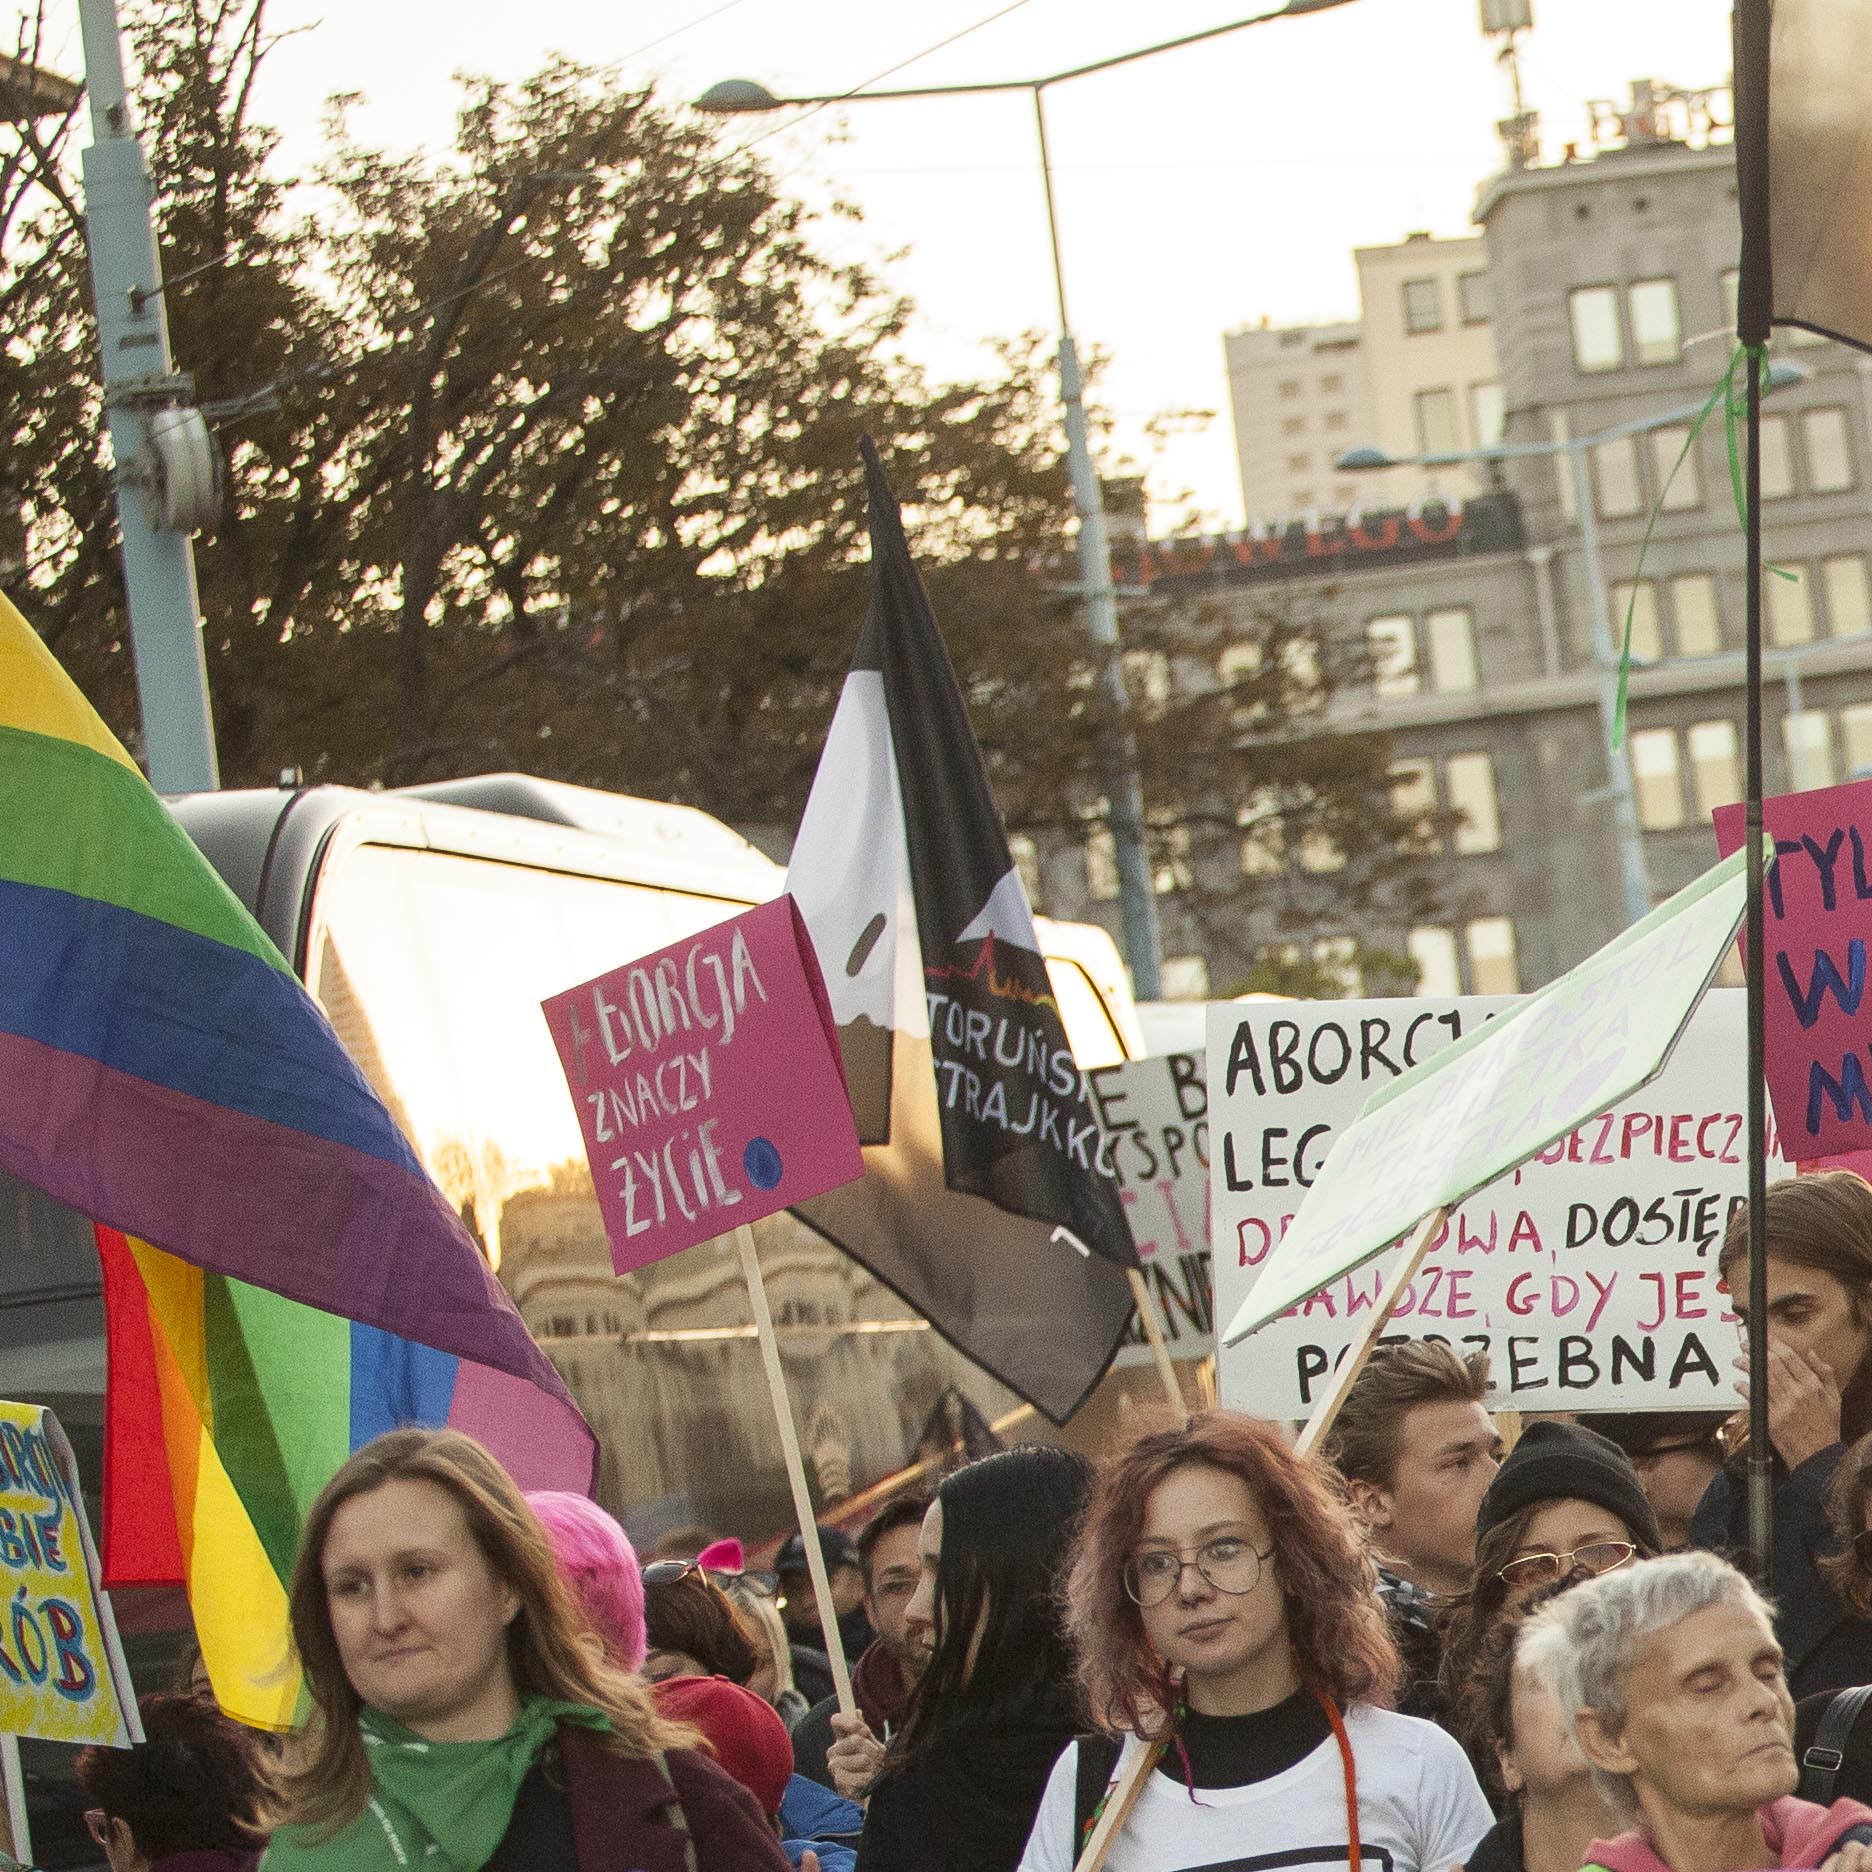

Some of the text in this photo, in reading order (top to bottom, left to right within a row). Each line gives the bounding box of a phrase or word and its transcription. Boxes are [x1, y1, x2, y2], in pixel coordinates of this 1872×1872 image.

[1775, 938, 1867, 1029] W
[587, 1047, 712, 1143] ZNACZY
[1505, 1270, 1619, 1333] GDY
